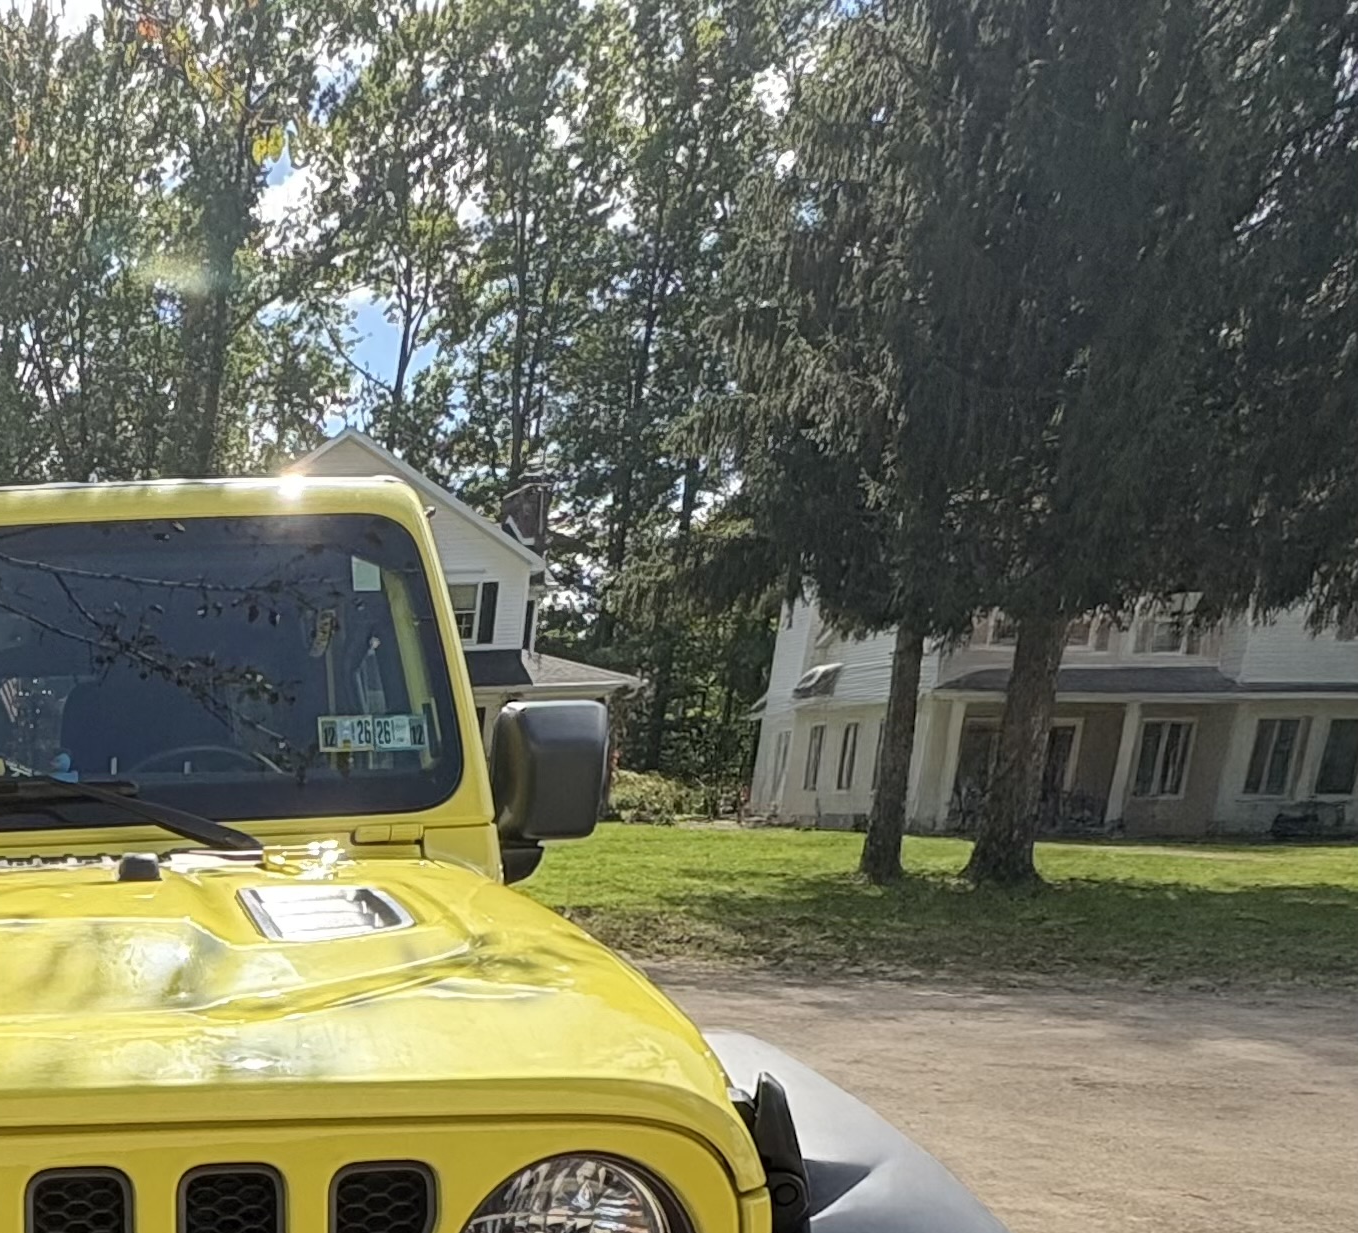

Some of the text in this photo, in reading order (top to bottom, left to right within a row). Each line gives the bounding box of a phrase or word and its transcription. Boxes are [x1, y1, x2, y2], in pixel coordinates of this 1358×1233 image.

[324, 727, 336, 747] 12
[357, 720, 371, 744] 26
[377, 720, 391, 744] 26
[411, 724, 424, 745] 12
